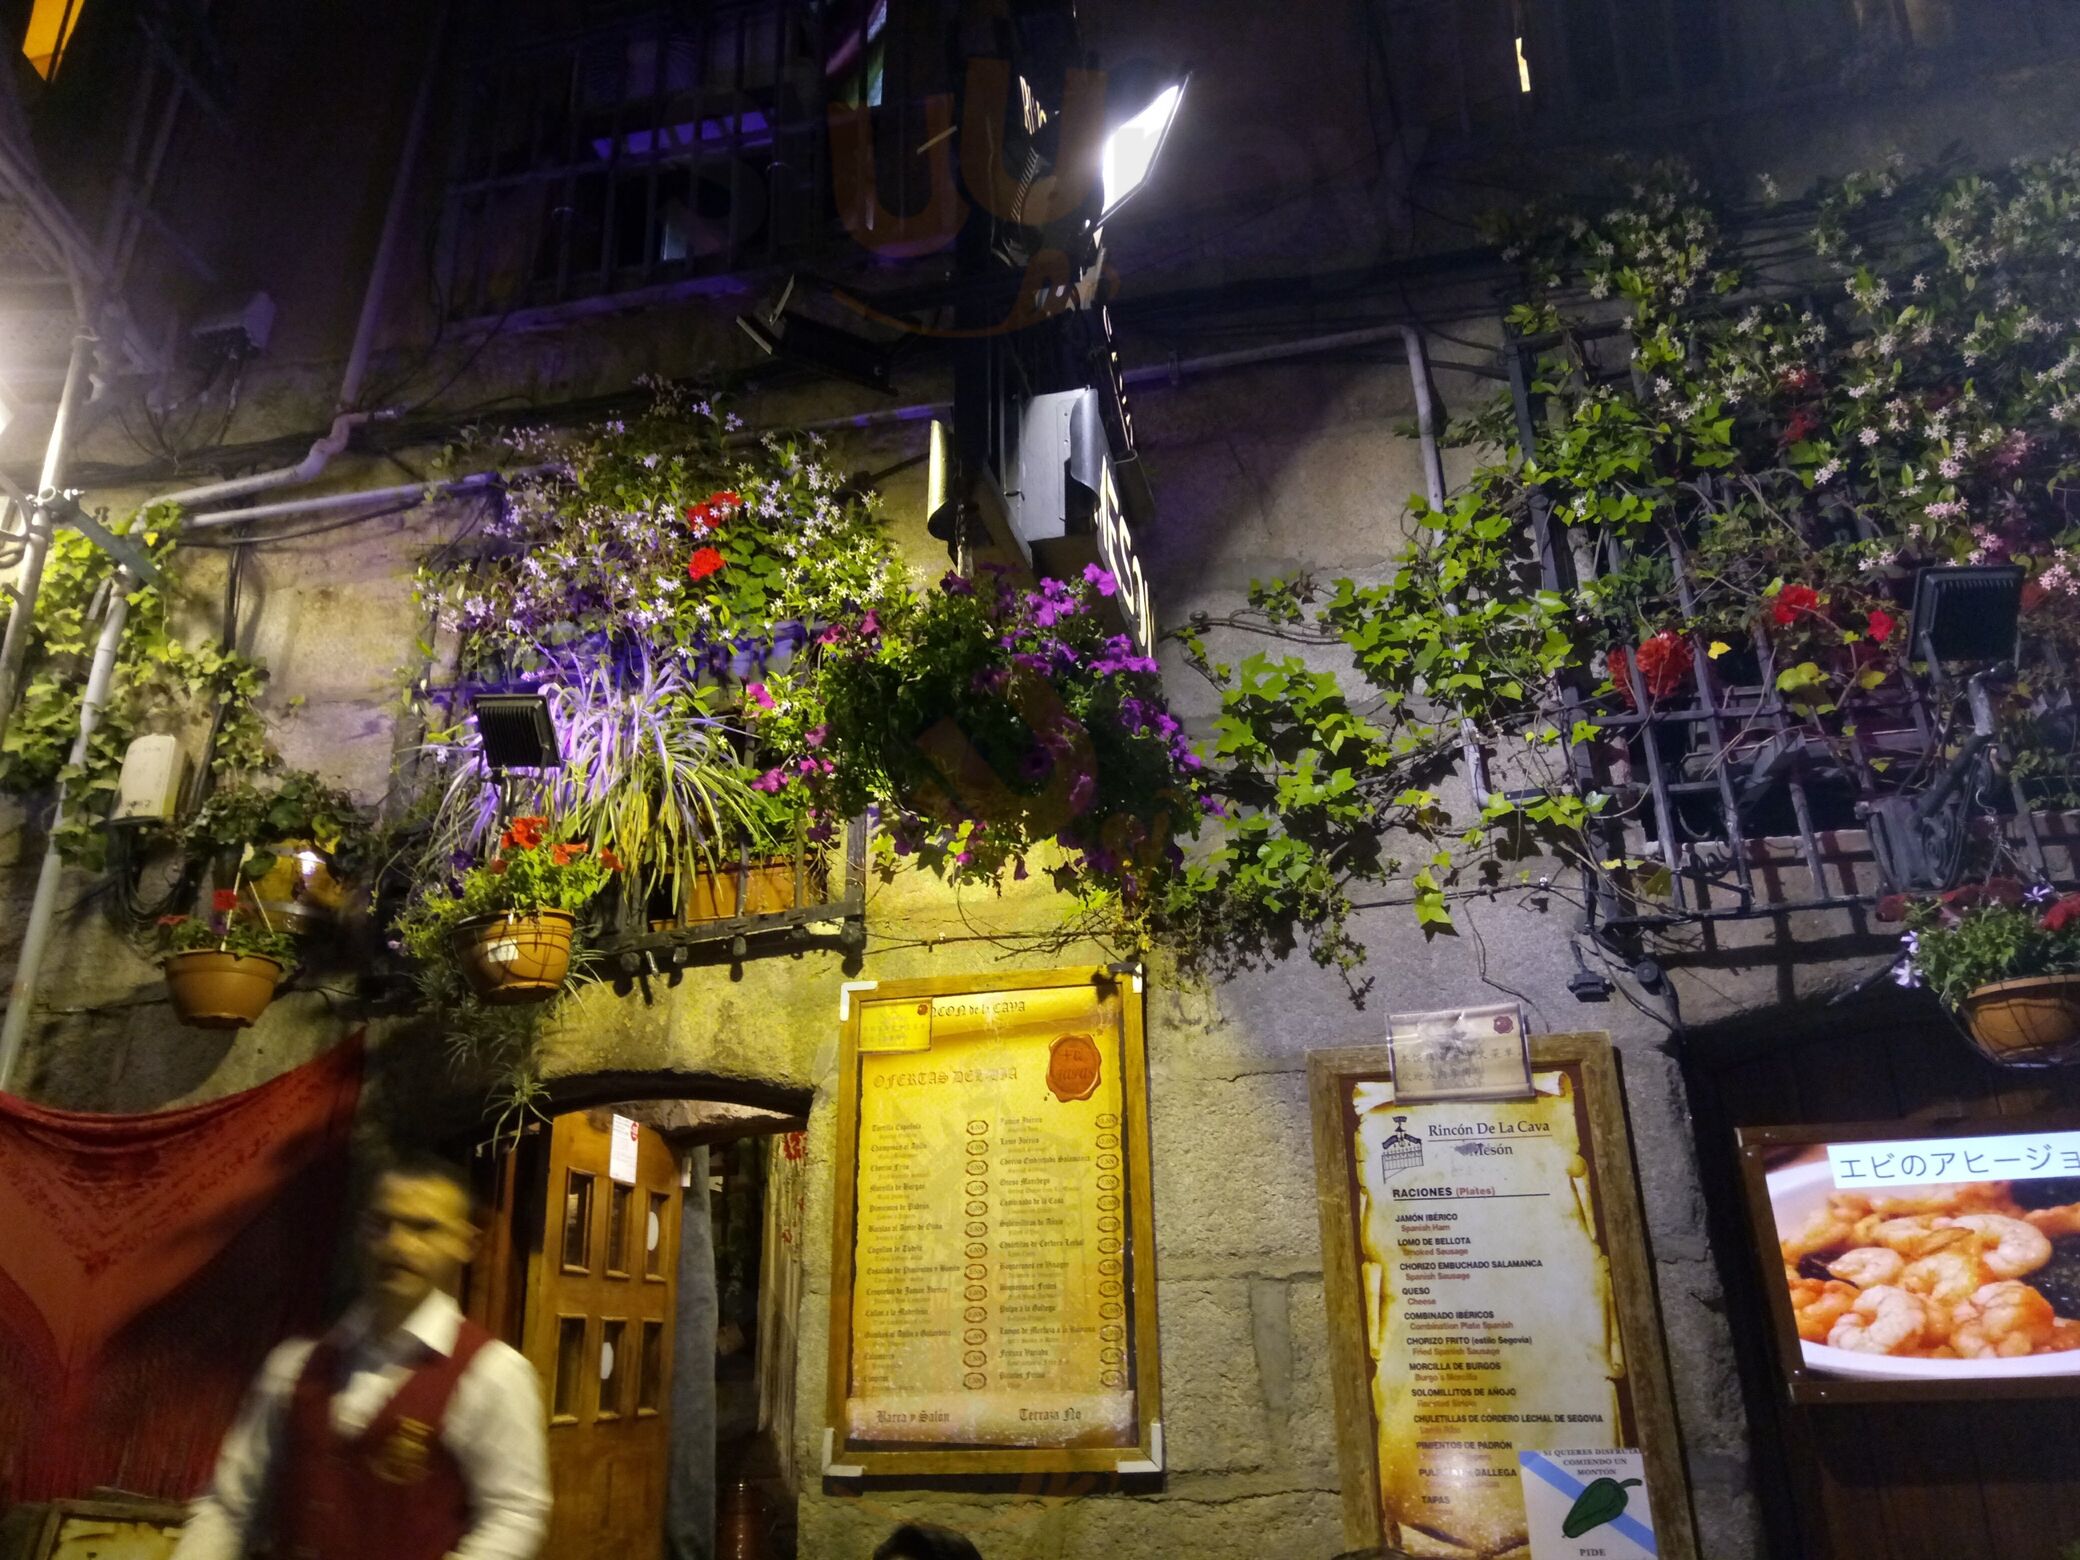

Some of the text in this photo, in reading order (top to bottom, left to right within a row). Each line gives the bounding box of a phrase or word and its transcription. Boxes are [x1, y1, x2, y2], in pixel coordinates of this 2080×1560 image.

[992, 1001, 1025, 1013] CAVA
[873, 1071, 949, 1089] OFERTAS
[1428, 1120, 1550, 1136] Rincón De La Cava
[1840, 1144, 2080, 1179] エビのアヒージョ
[1392, 1186, 1496, 1198] RACIONES (Plates)
[1395, 1211, 1458, 1222] JAMÓN IBÉRICO
[1397, 1237, 1471, 1246] LOMO DE BELLOTA
[1399, 1259, 1543, 1271] CHORIZO EMBUCHADO SALAMANCA
[1402, 1287, 1430, 1295] QUESO
[1404, 1310, 1494, 1320] COMBINADO IBÉRICOS
[1406, 1337, 1444, 1345] CHORIZO
[1445, 1336, 1470, 1345] FRITO
[1409, 1362, 1502, 1371] MORCILLA DE BURGOS
[1473, 1388, 1485, 1396] DE
[1486, 1386, 1516, 1396] AÑOJO
[1063, 1408, 1083, 1422] No
[1413, 1413, 1603, 1424] CHULETILLAS DE CORDERO LECHAL DE SEGOVIA
[1464, 1441, 1476, 1449] DE
[1478, 1441, 1513, 1449] PADRÓN
[1554, 1449, 1593, 1457] QUIERES
[1562, 1458, 1612, 1466] COMIENDO
[1579, 1548, 1606, 1556] PIDE
